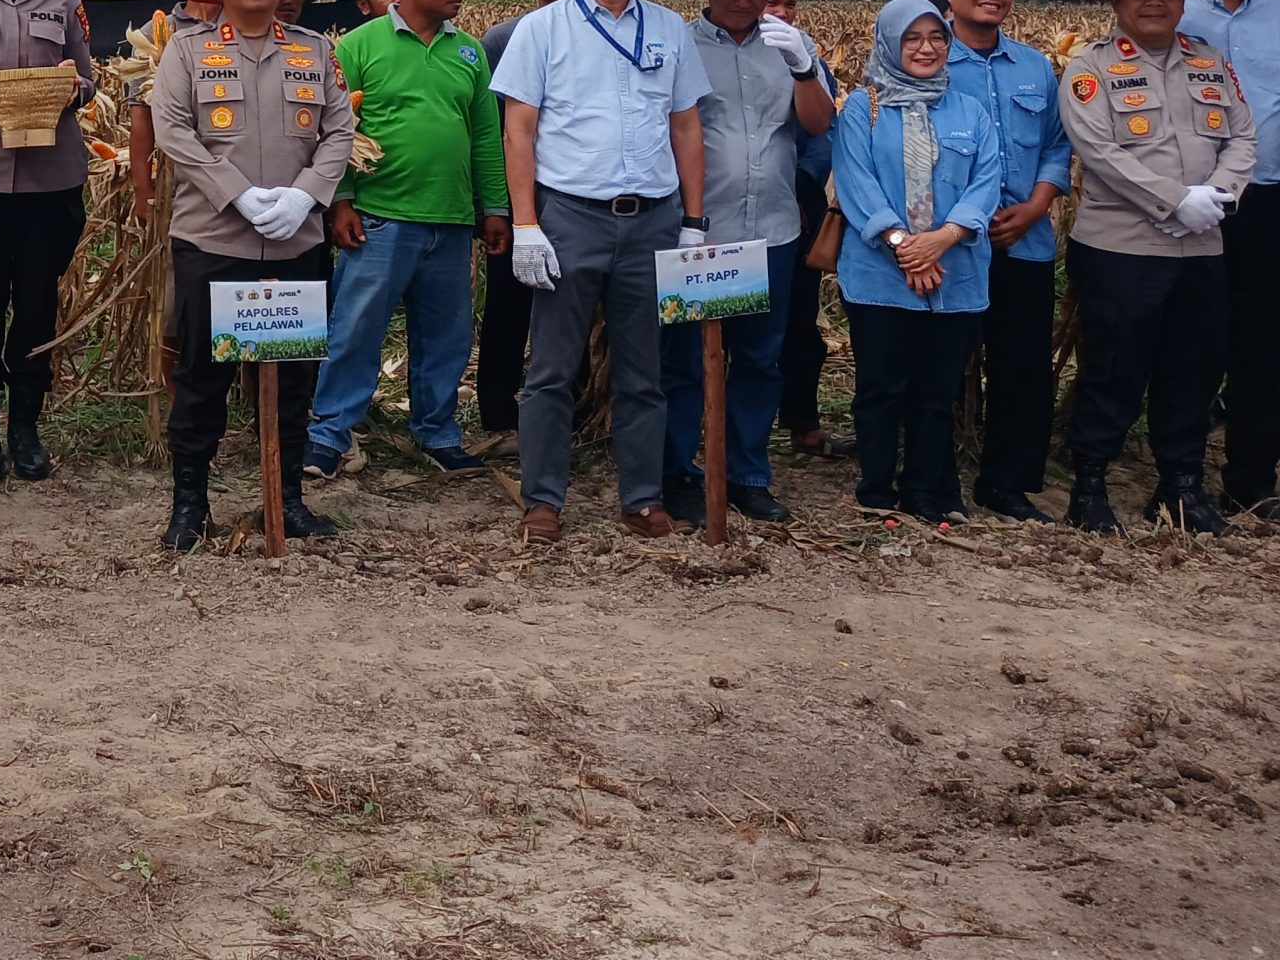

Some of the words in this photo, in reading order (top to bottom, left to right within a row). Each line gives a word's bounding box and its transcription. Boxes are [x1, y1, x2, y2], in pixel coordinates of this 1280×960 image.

[29, 12, 64, 25] POLRI
[198, 69, 239, 80] JOHN
[284, 70, 321, 82] POLRI
[1187, 72, 1225, 84] POLRI
[685, 274, 704, 286] PT.
[706, 269, 740, 284] RAPP
[237, 306, 300, 319] KAPOLRES
[233, 319, 304, 332] PELALAWAN
